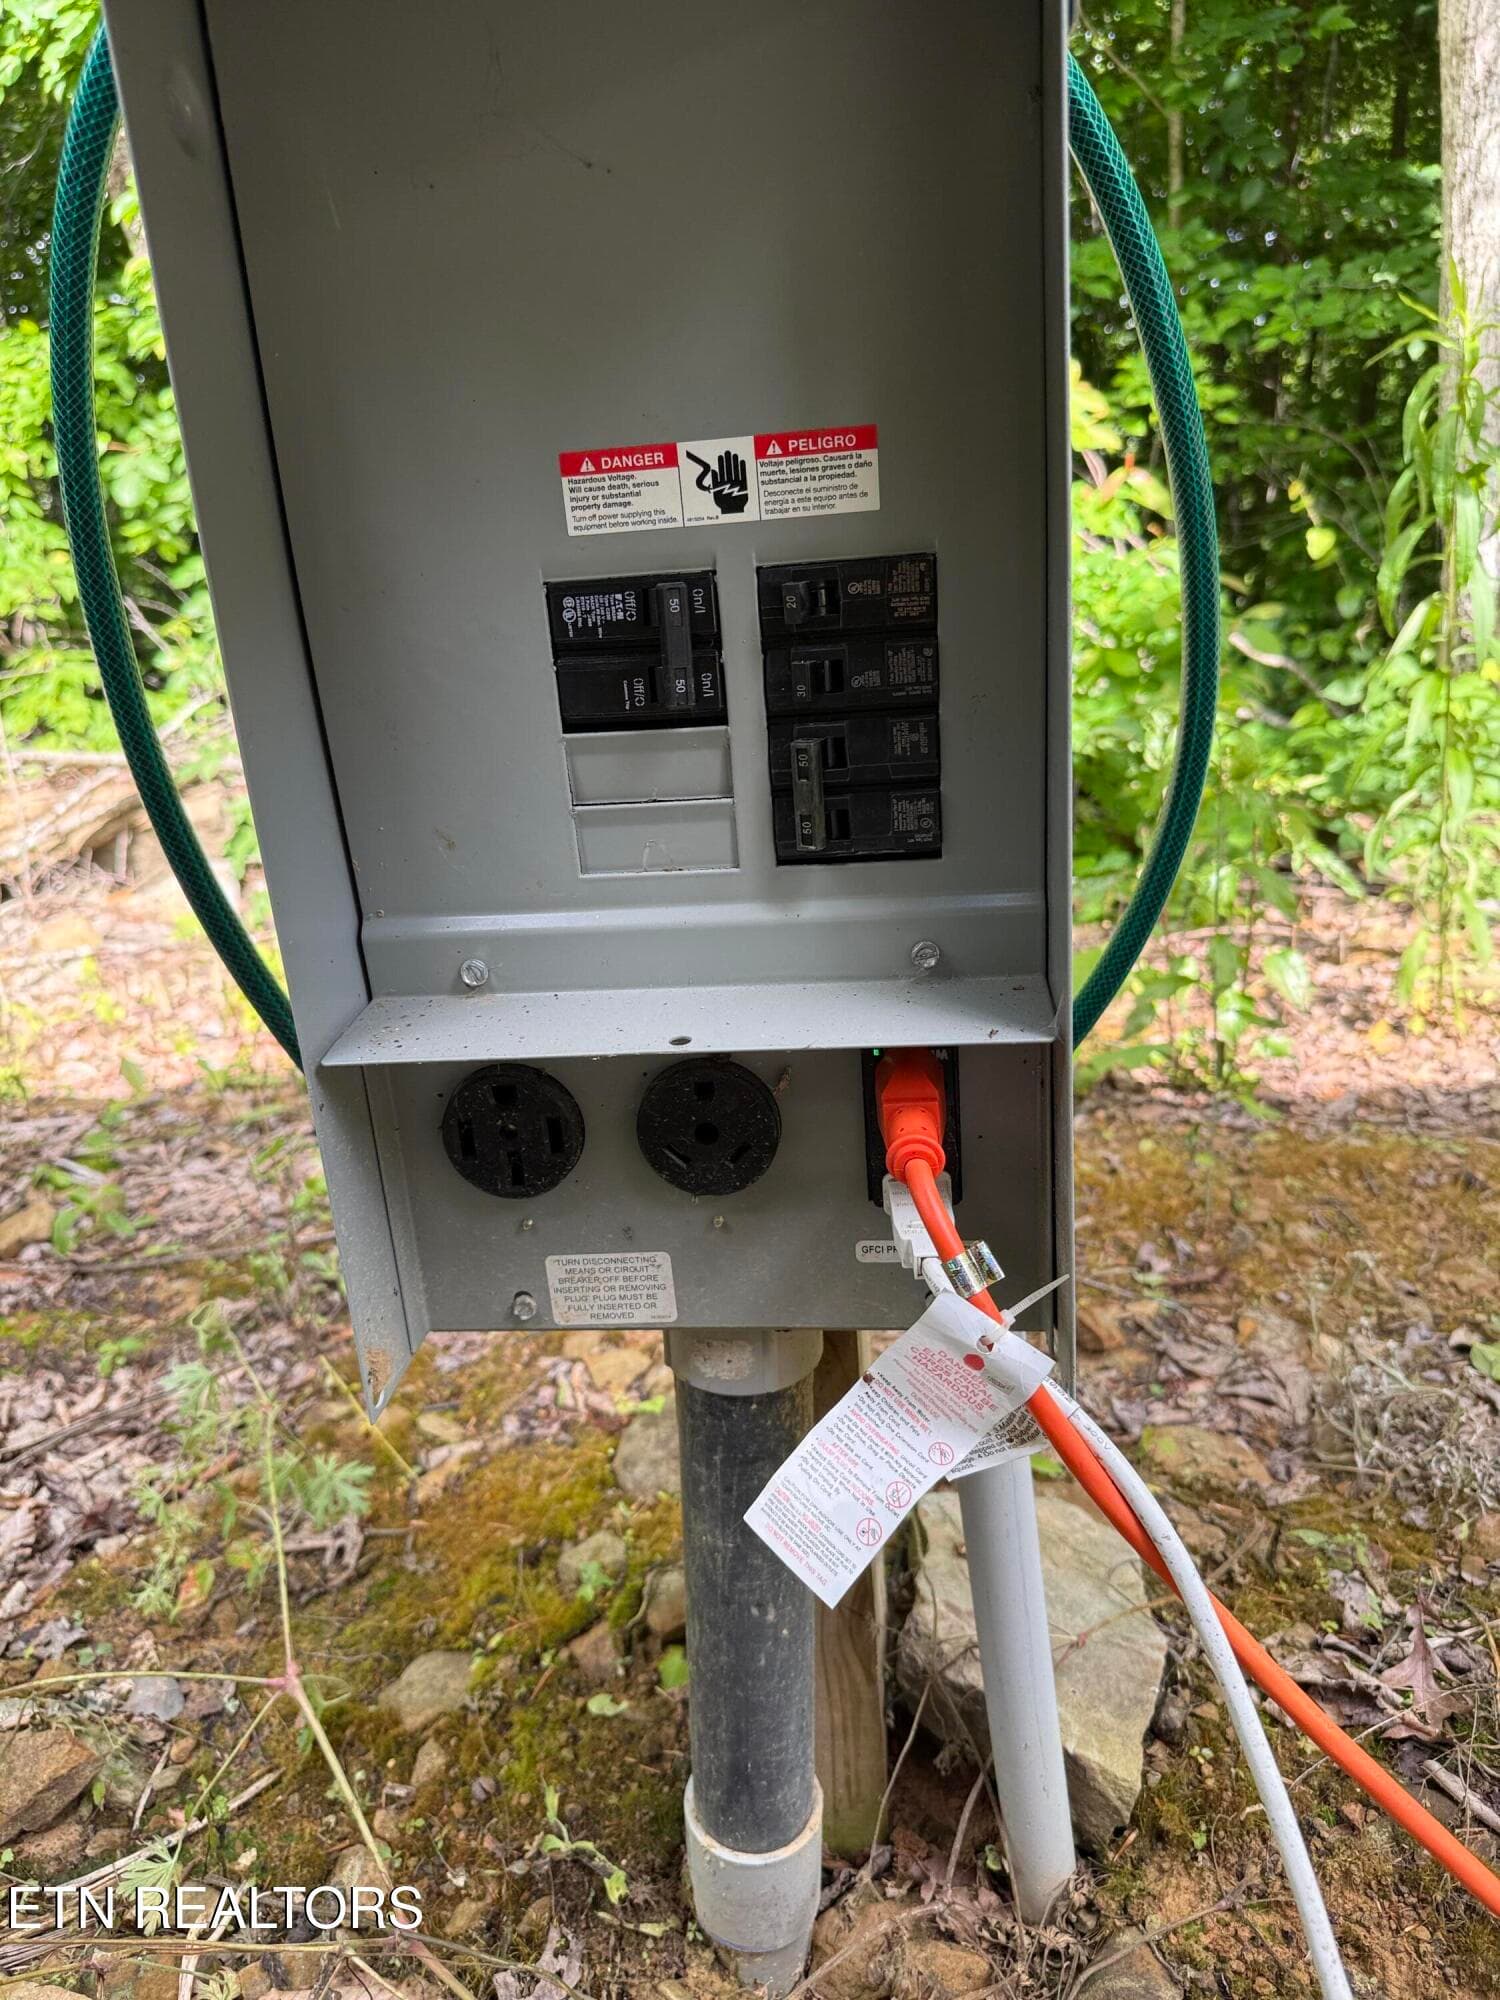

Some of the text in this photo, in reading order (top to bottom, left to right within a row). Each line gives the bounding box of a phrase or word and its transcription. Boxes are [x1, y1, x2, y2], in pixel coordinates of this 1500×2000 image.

[788, 434, 856, 451] PELIGRO
[601, 451, 664, 469] DANGER
[759, 459, 783, 468] Voltaje
[785, 456, 821, 466] peligroso.
[823, 452, 853, 462] Causará
[760, 469, 787, 477] muerte,
[789, 465, 819, 474] lesiones
[821, 464, 845, 472] graves
[854, 460, 872, 468] daño
[567, 473, 636, 485] Hazardous Voltage.
[760, 476, 801, 485] substancial
[818, 470, 856, 481] propiedad.
[607, 482, 630, 491] death,
[632, 479, 658, 488] serious
[763, 487, 803, 497] Desconecte
[812, 484, 847, 492] suministro
[569, 495, 589, 503] injury
[601, 490, 641, 499] substantial
[813, 493, 836, 502] equipo
[838, 491, 856, 499] antes
[570, 500, 633, 512] property damage.
[764, 506, 789, 515] trabajar
[620, 509, 652, 518] supplying
[573, 522, 607, 532] equipment
[608, 520, 629, 528] before
[631, 517, 656, 527] working
[669, 599, 679, 612] 50
[787, 595, 796, 609] 20
[676, 679, 686, 693] 50
[797, 685, 806, 697] 30
[799, 754, 808, 767] 50
[802, 822, 811, 834] 50
[861, 1245, 883, 1253] GFCI
[583, 1256, 656, 1264] DISCONNECTING
[568, 1304, 594, 1312] FULLY
[922, 1346, 994, 1402] ELECTRICAL
[937, 1348, 988, 1389] DANGER
[909, 1344, 952, 1378] CORDS
[952, 1376, 979, 1398] CAN
[979, 1396, 998, 1413] BE
[912, 1353, 984, 1411] HAZARDOUS
[878, 1373, 892, 1386] Keep
[890, 1384, 904, 1398] Away
[902, 1396, 917, 1410] From
[863, 1390, 876, 1404] Away
[874, 1401, 889, 1416] From
[868, 1385, 881, 1398] Keep
[879, 1396, 900, 1416] Children
[899, 1415, 910, 1426] and
